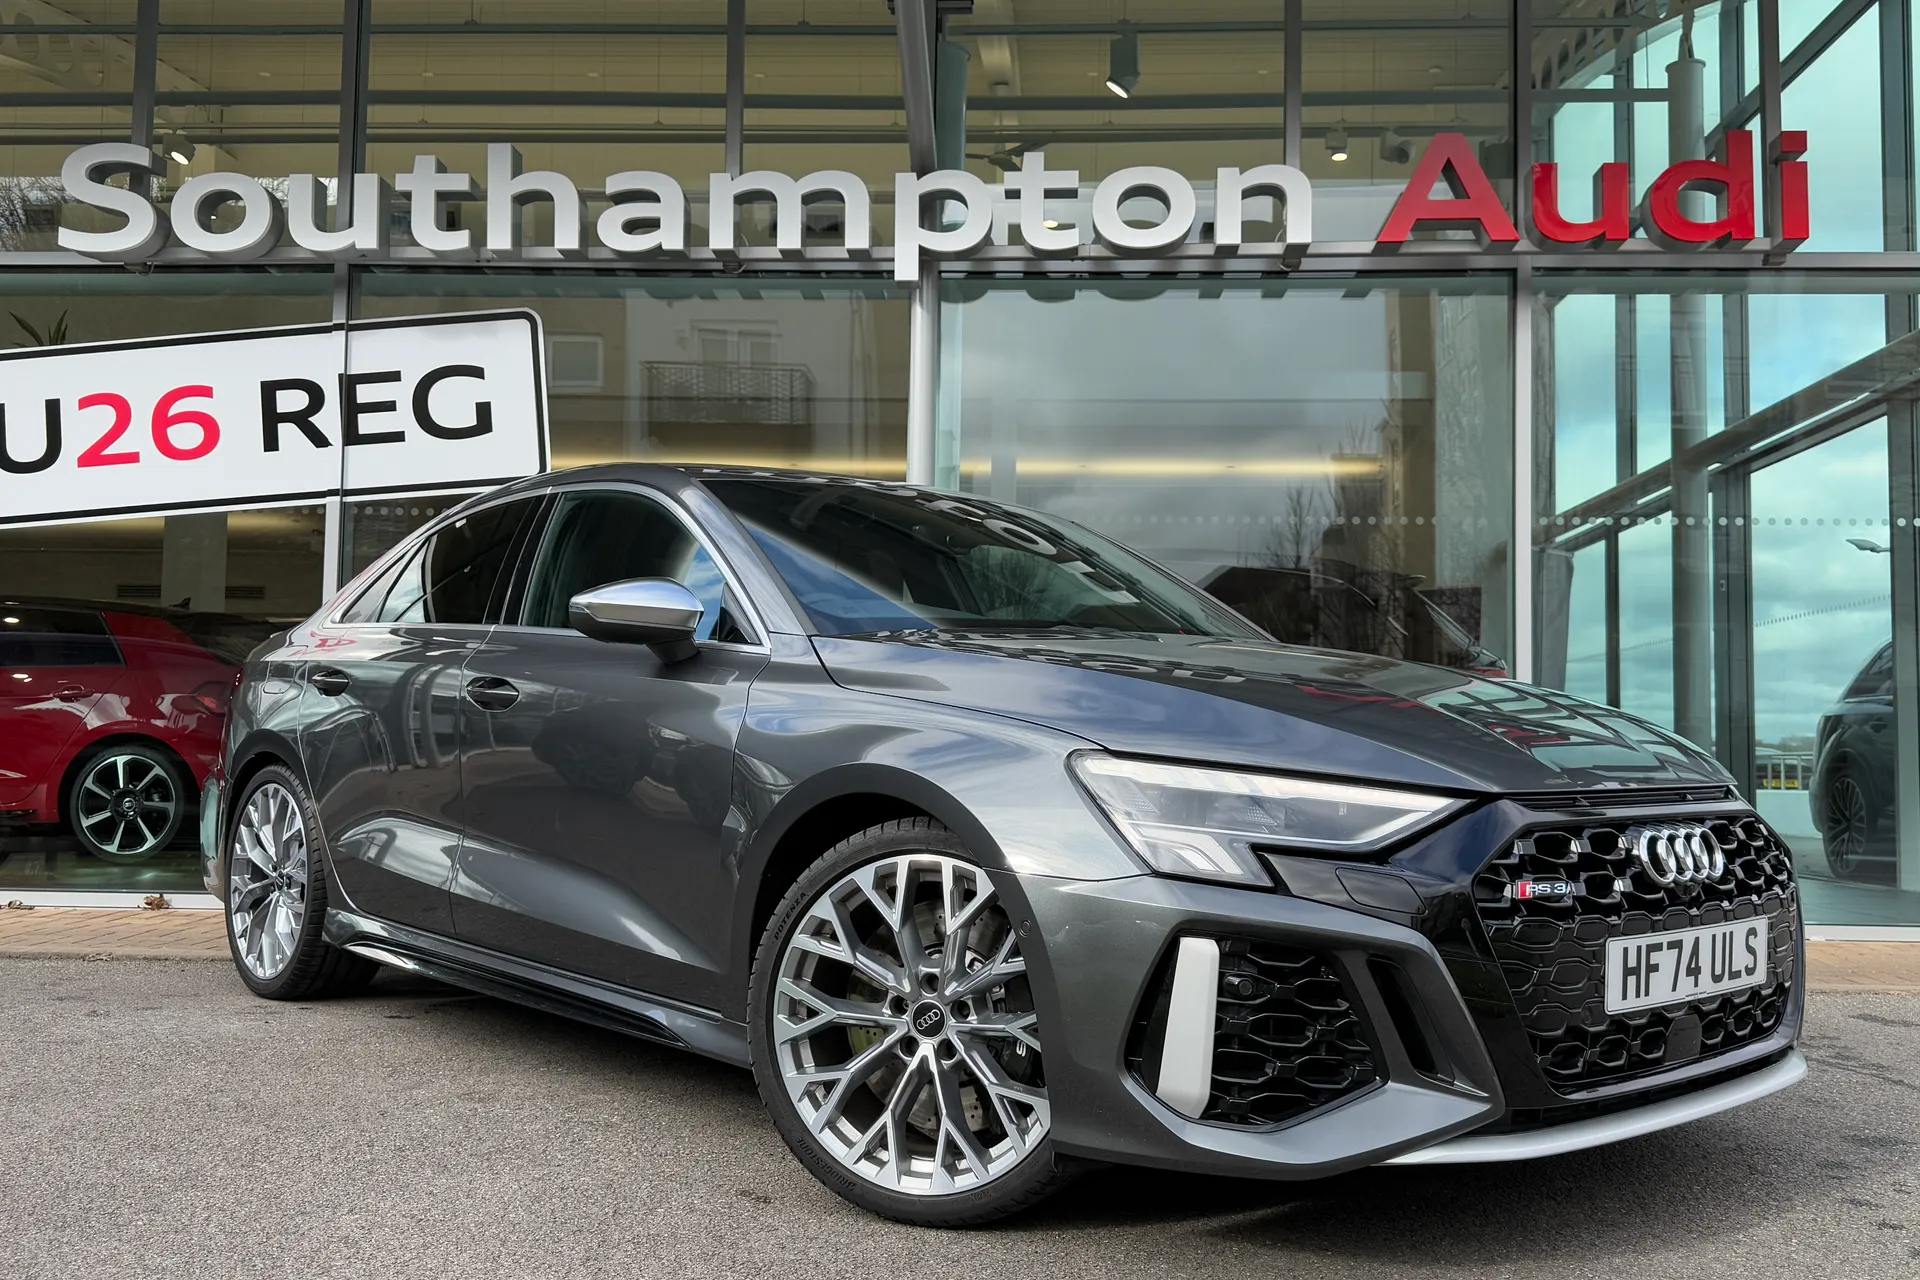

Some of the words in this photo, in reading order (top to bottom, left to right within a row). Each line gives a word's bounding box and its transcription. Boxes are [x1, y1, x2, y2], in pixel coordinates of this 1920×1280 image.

[57, 142, 1315, 283] Southampton
[1377, 130, 1810, 245] Audi
[0, 384, 221, 474] U26
[260, 364, 494, 453] REG
[774, 892, 810, 941] POTENZA
[1622, 936, 1702, 1001] HF74
[1710, 926, 1758, 984] ULS
[795, 1136, 857, 1192] BRIDGESTONE
